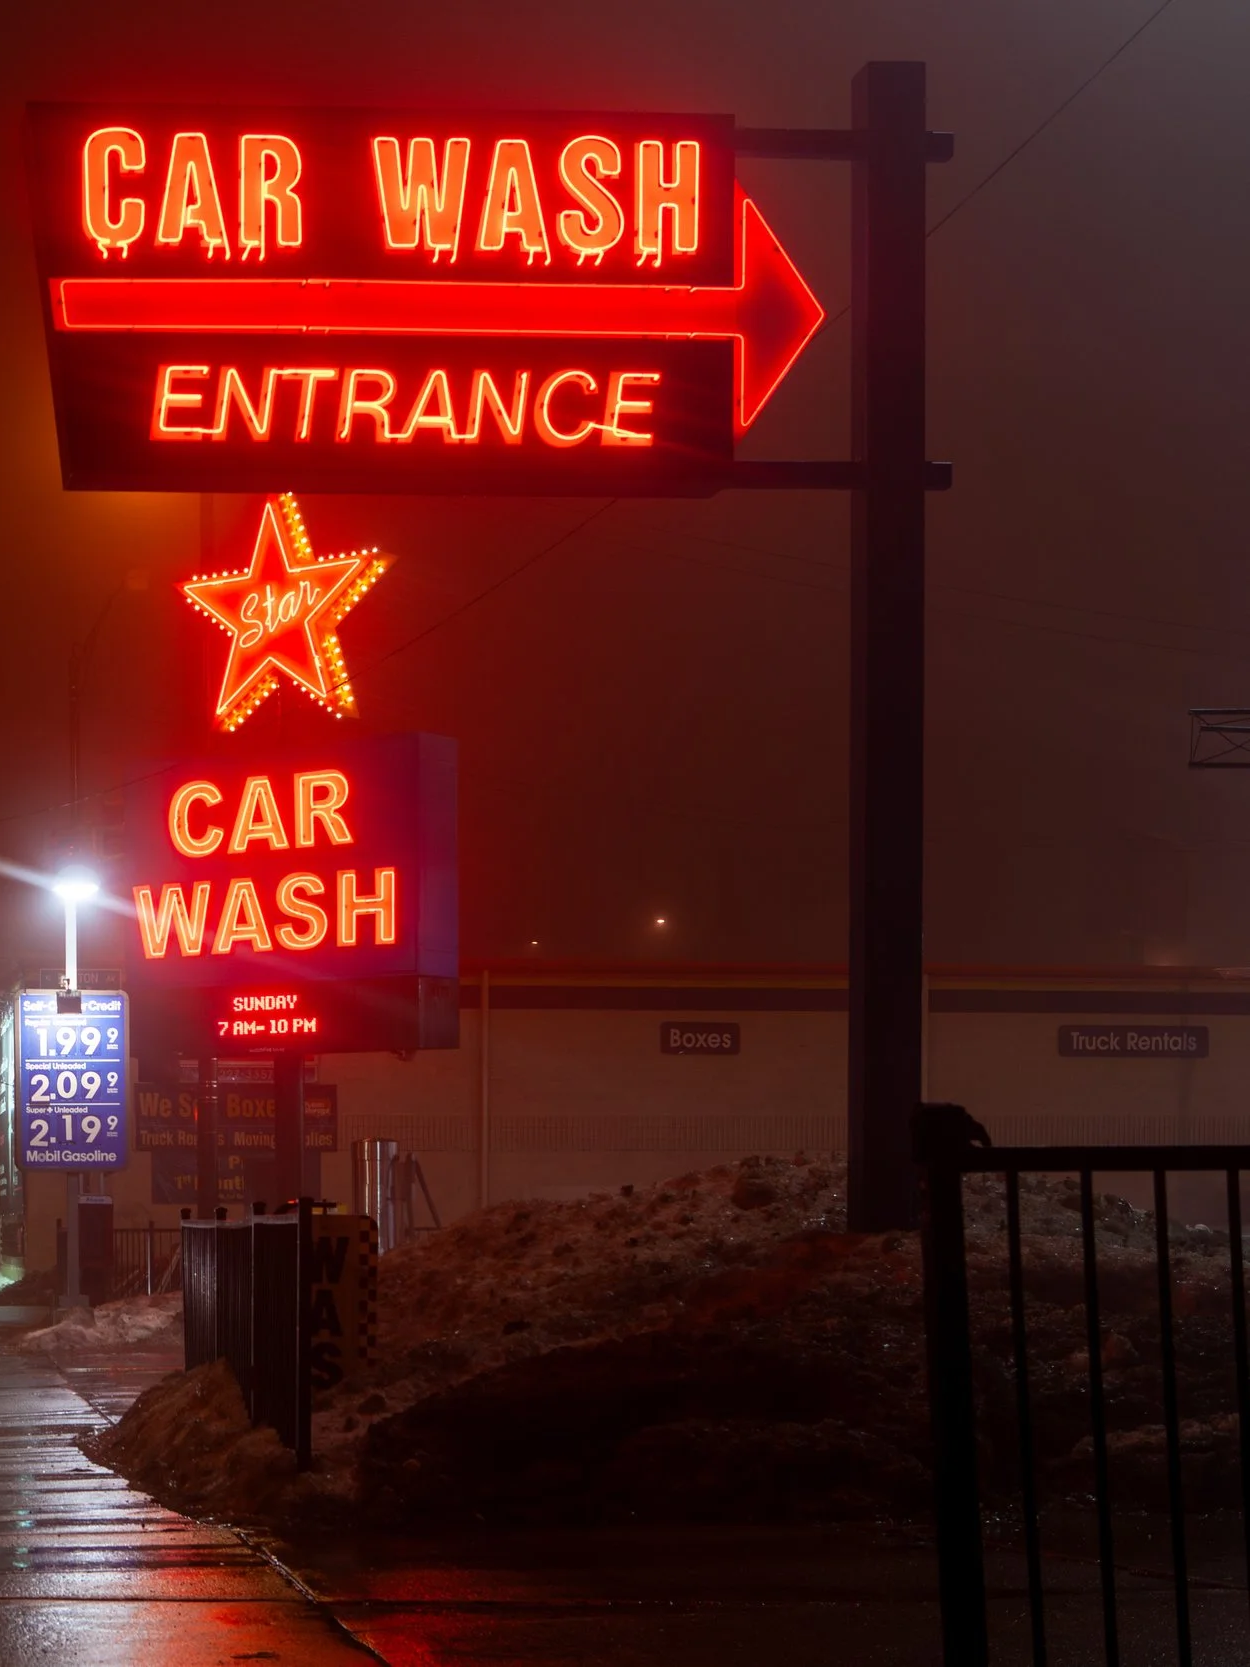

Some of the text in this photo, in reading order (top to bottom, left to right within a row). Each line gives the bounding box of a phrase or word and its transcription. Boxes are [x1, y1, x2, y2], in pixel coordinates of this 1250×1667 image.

[82, 127, 701, 265] CAR WASH
[151, 365, 661, 447] ENTRANCE
[239, 580, 320, 648] Star
[168, 769, 354, 858] CAR
[133, 867, 396, 959] WASH
[88, 1000, 121, 1012] Credit
[233, 994, 298, 1012] SUNDAY
[217, 1021, 229, 1036] 7
[269, 1019, 289, 1034] 10
[292, 1017, 317, 1034] PM
[36, 1026, 101, 1057] 1.99
[669, 1029, 732, 1049] Boxes
[1070, 1032, 1197, 1051] Truck Rentals
[25, 1062, 87, 1071] Special Unleaded
[31, 1070, 119, 1102] 2.09 9
[54, 1106, 88, 1114] Unleaded
[138, 1092, 172, 1117] We
[226, 1093, 275, 1118] Boxe
[30, 1114, 119, 1147] 2.19 9
[140, 1130, 173, 1146] Truck
[26, 1150, 117, 1162] Mobil Gasoline
